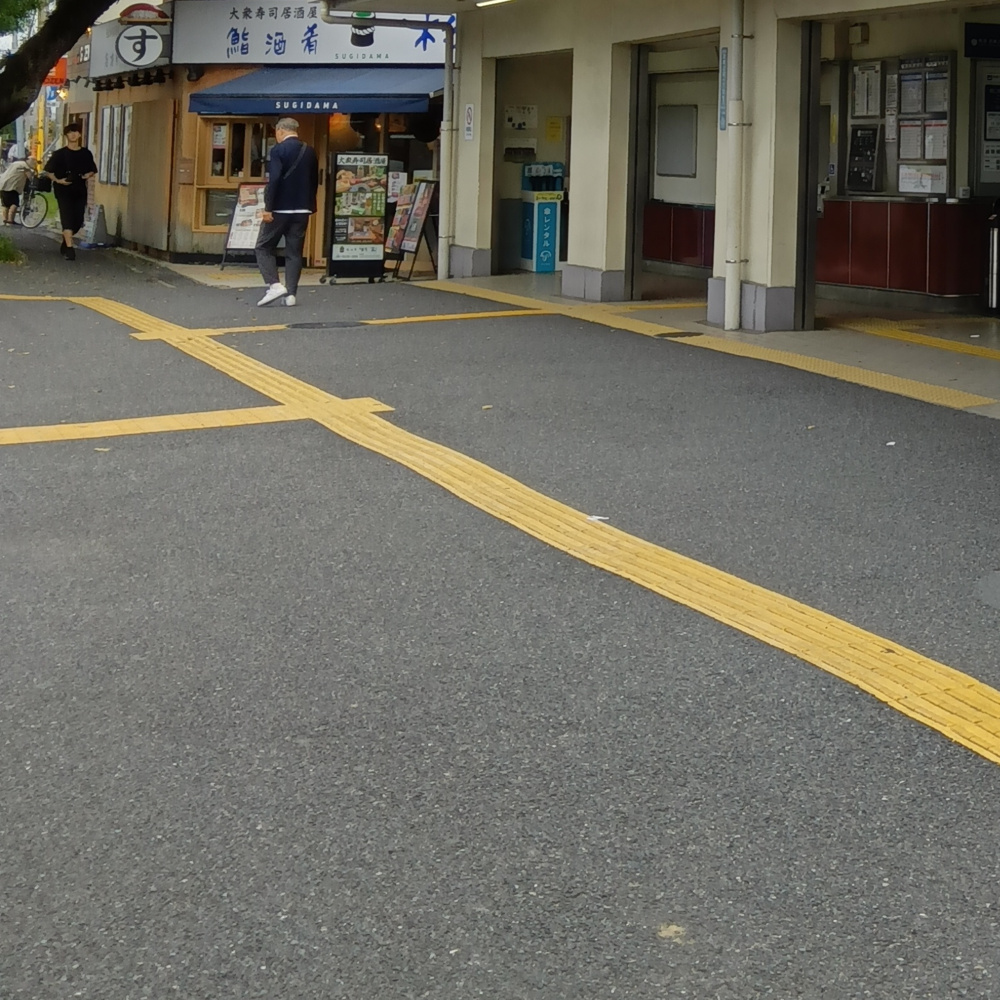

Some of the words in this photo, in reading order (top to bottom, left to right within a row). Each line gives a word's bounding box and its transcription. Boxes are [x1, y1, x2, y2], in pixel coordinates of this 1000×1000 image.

[229, 6, 318, 20] 大衆寿司居酒屋
[124, 28, 158, 63] す
[275, 101, 339, 110] SUGIDAMA
